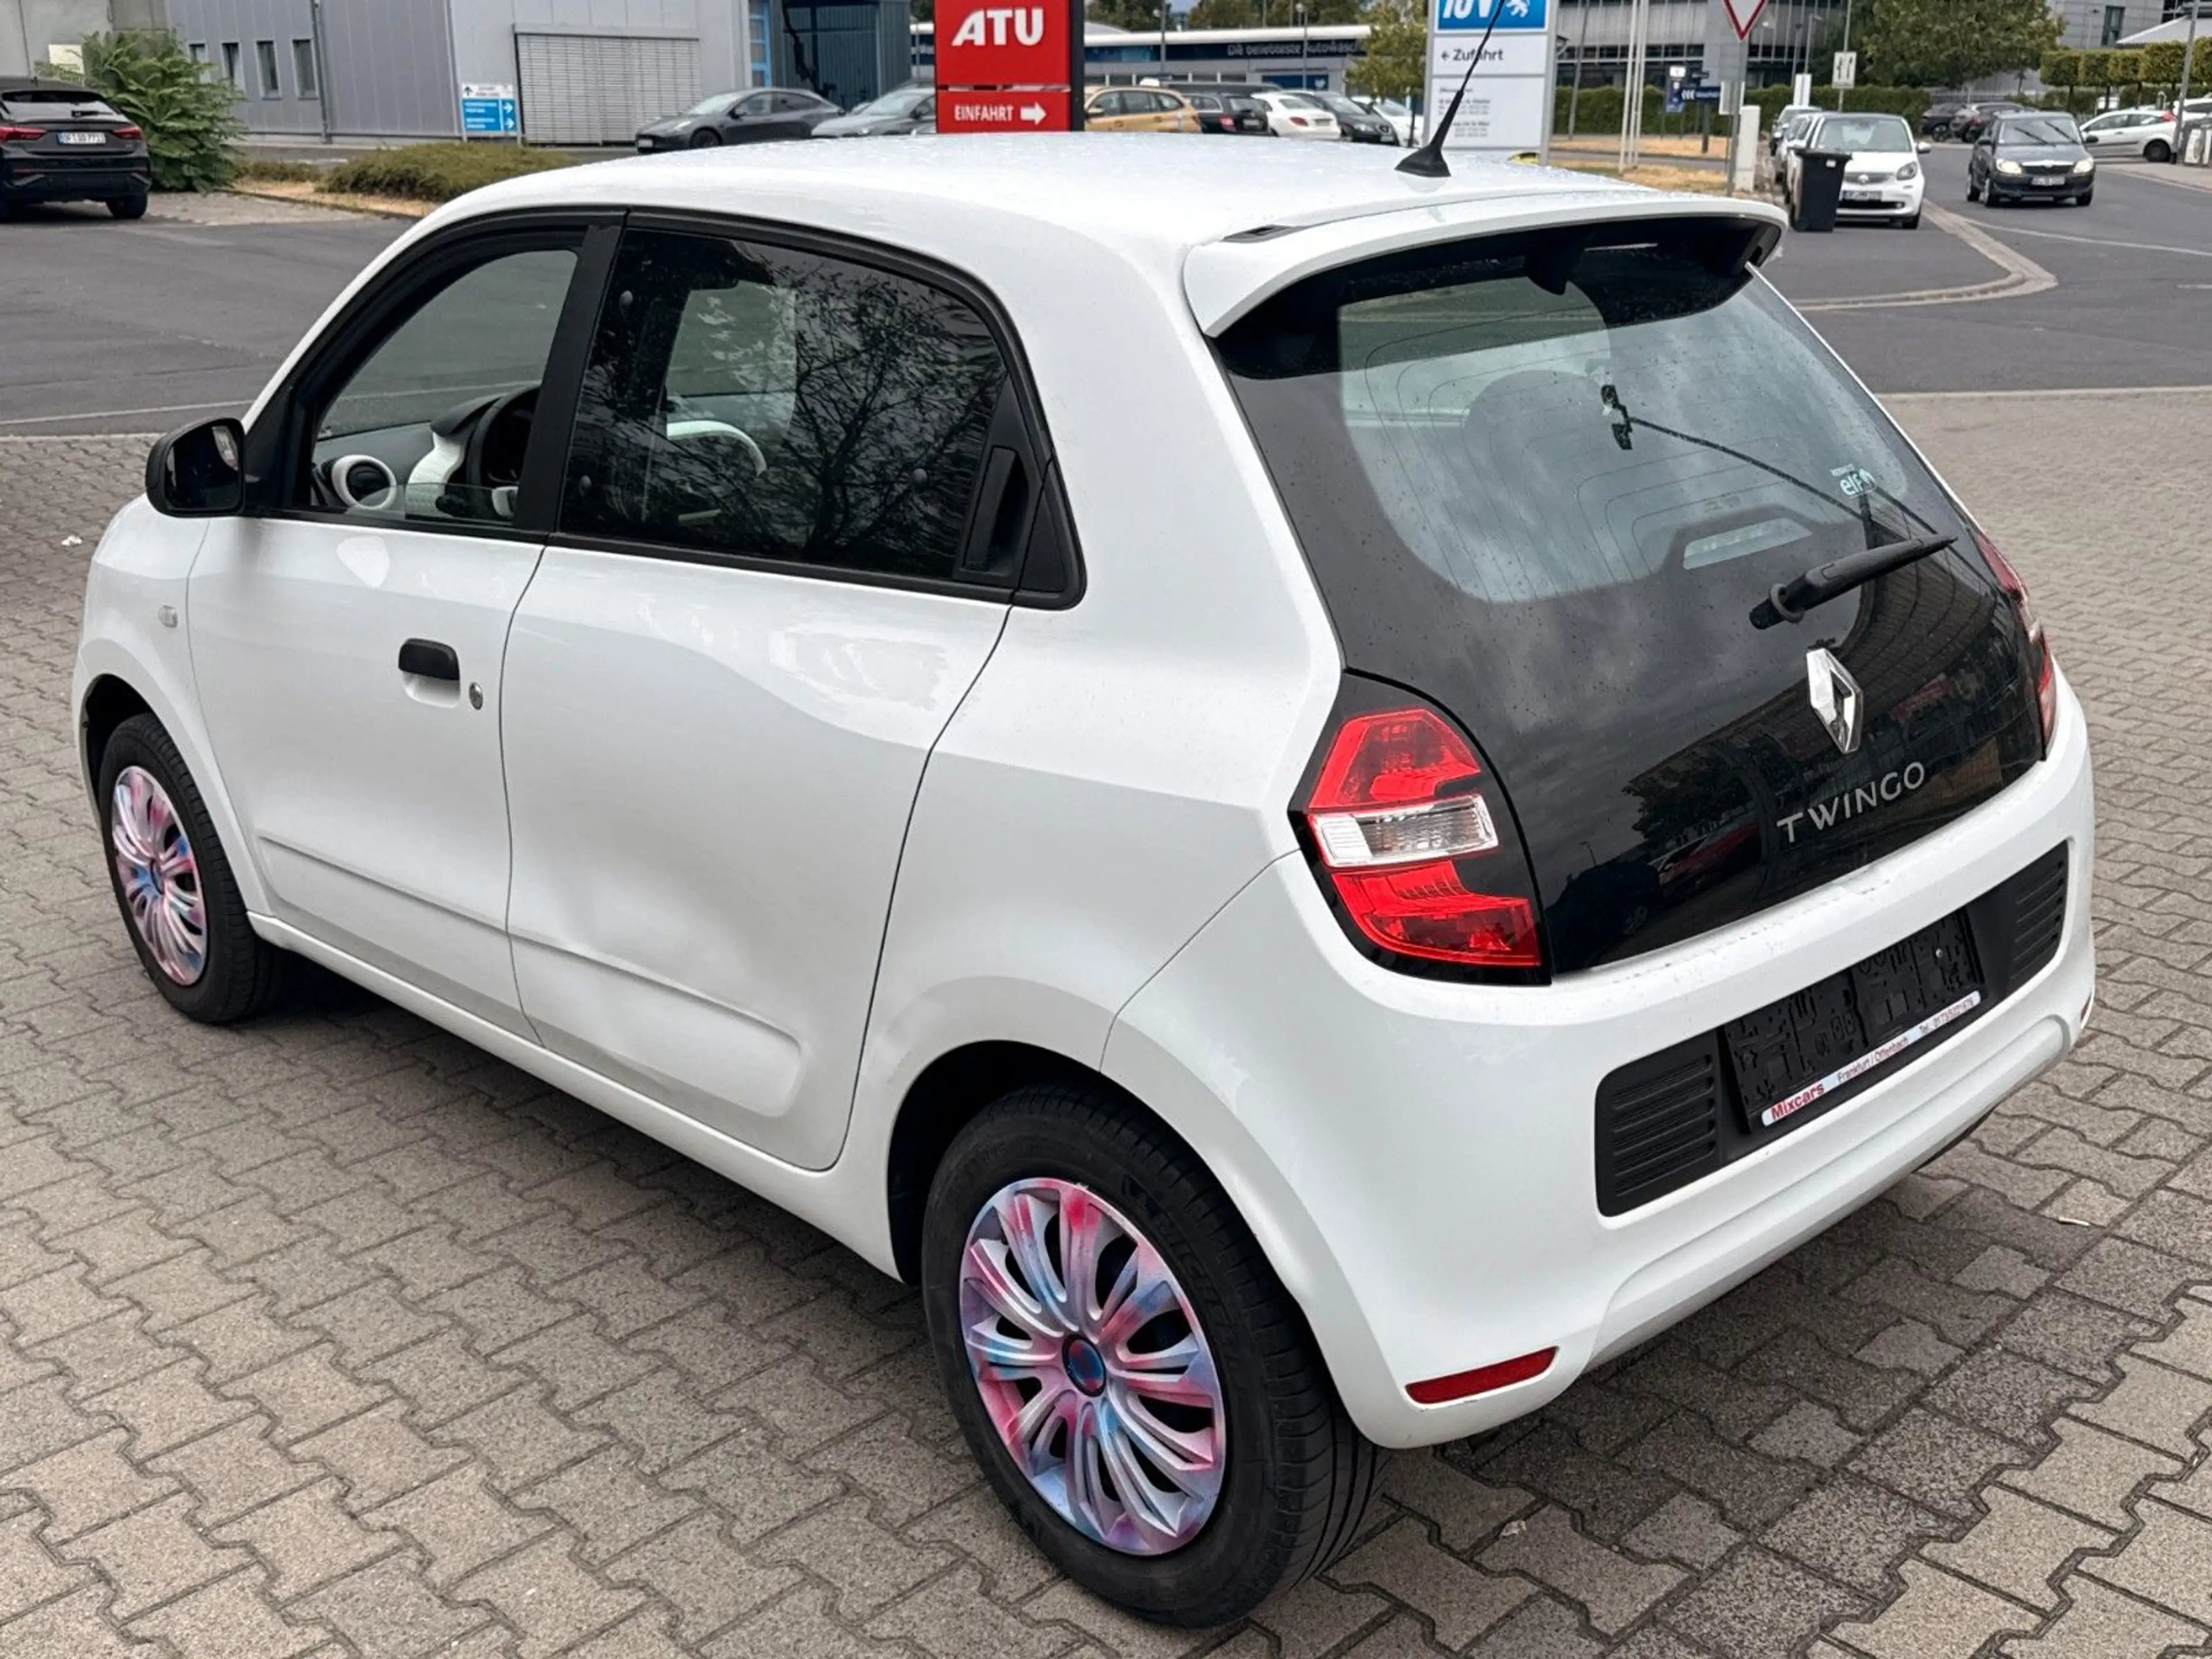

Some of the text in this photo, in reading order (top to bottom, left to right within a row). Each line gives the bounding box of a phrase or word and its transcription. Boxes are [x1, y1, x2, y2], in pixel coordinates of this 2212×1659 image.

[952, 8, 1044, 46] ATU
[954, 104, 1014, 122] EINFAHRT
[1776, 761, 1925, 843] TWINGO
[1771, 1083, 1825, 1120] Mixcars
